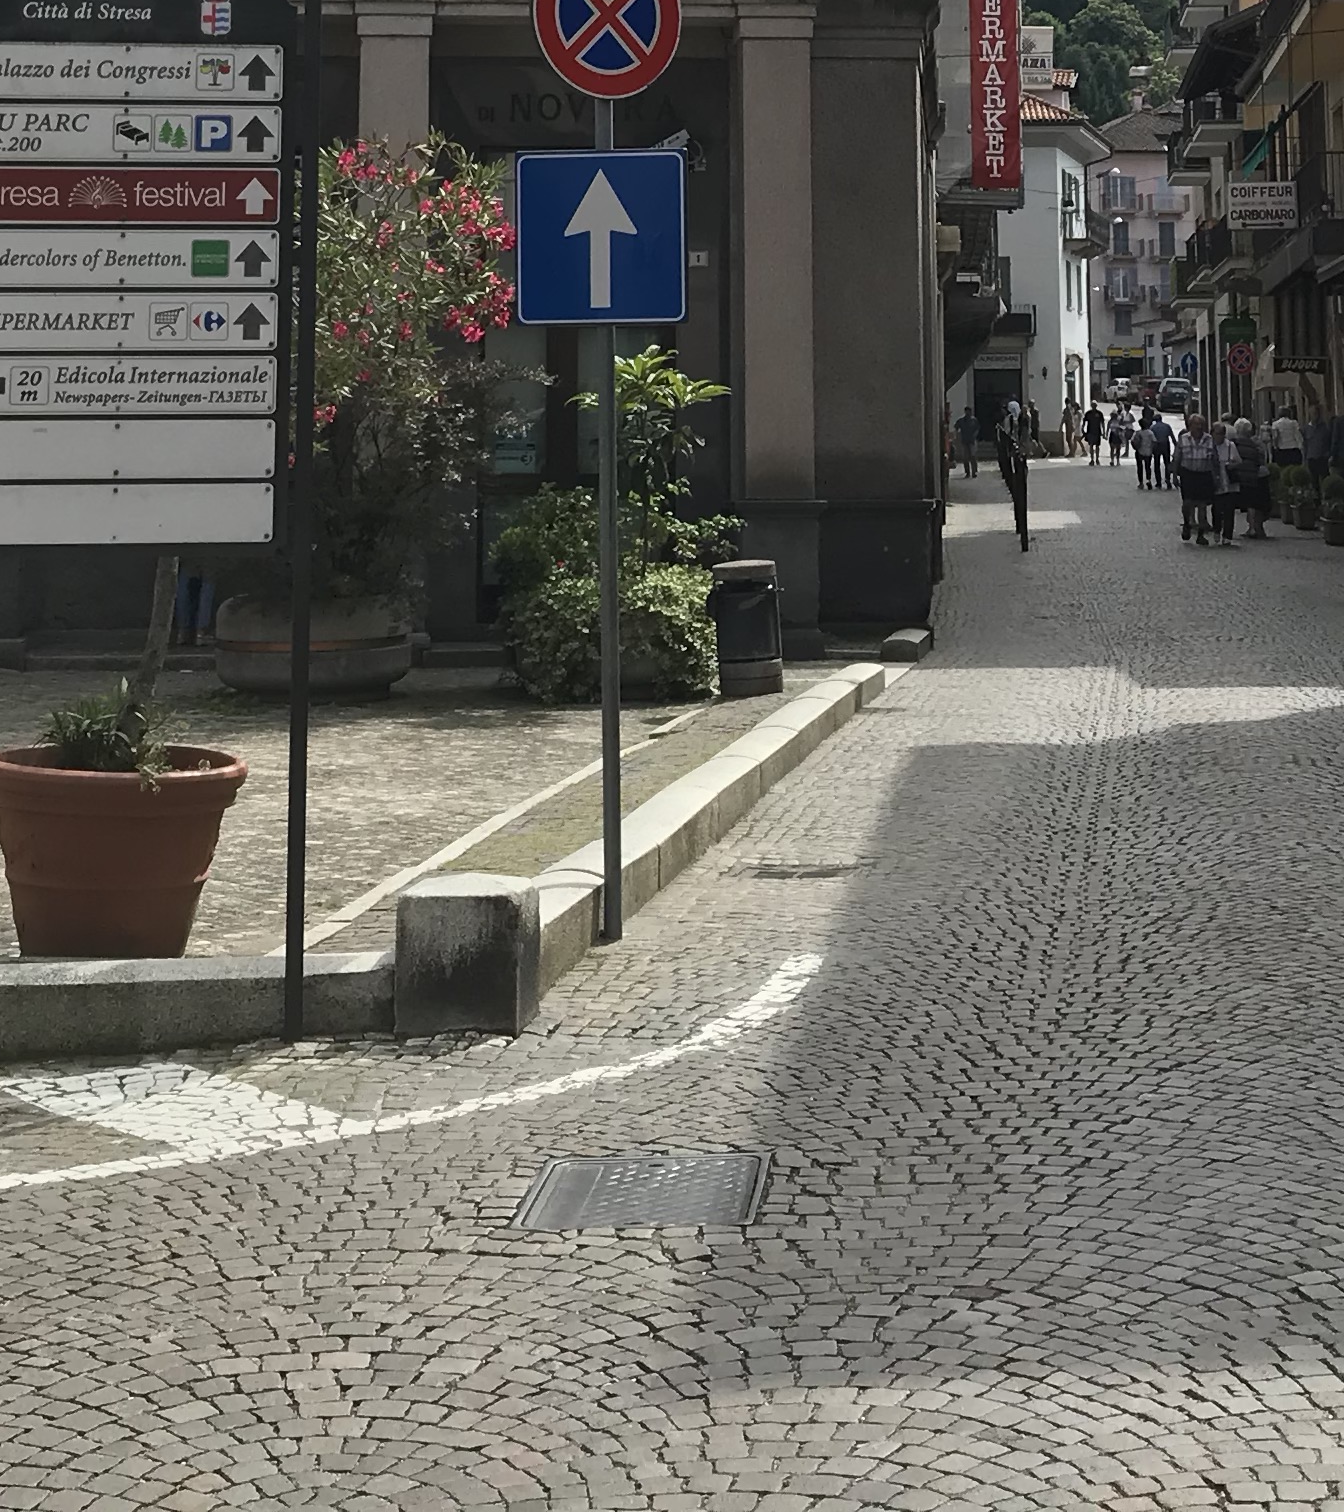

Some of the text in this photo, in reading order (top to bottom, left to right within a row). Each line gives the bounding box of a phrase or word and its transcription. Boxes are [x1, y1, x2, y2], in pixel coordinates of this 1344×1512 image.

[23, 1, 152, 20] Città di Stresa
[61, 59, 91, 79] dei
[97, 60, 192, 85] Congressi
[510, 93, 677, 123] NOVRA
[22, 113, 89, 133] PARC
[201, 120, 227, 148] P
[134, 182, 225, 206] festival
[1231, 186, 1293, 199] COIFFEUR
[83, 248, 101, 272] of
[105, 249, 187, 268] Benetton.
[1281, 359, 1320, 369] BIJOUX
[17, 366, 268, 386] 20 Edicola Internazionale
[20, 390, 38, 402] m
